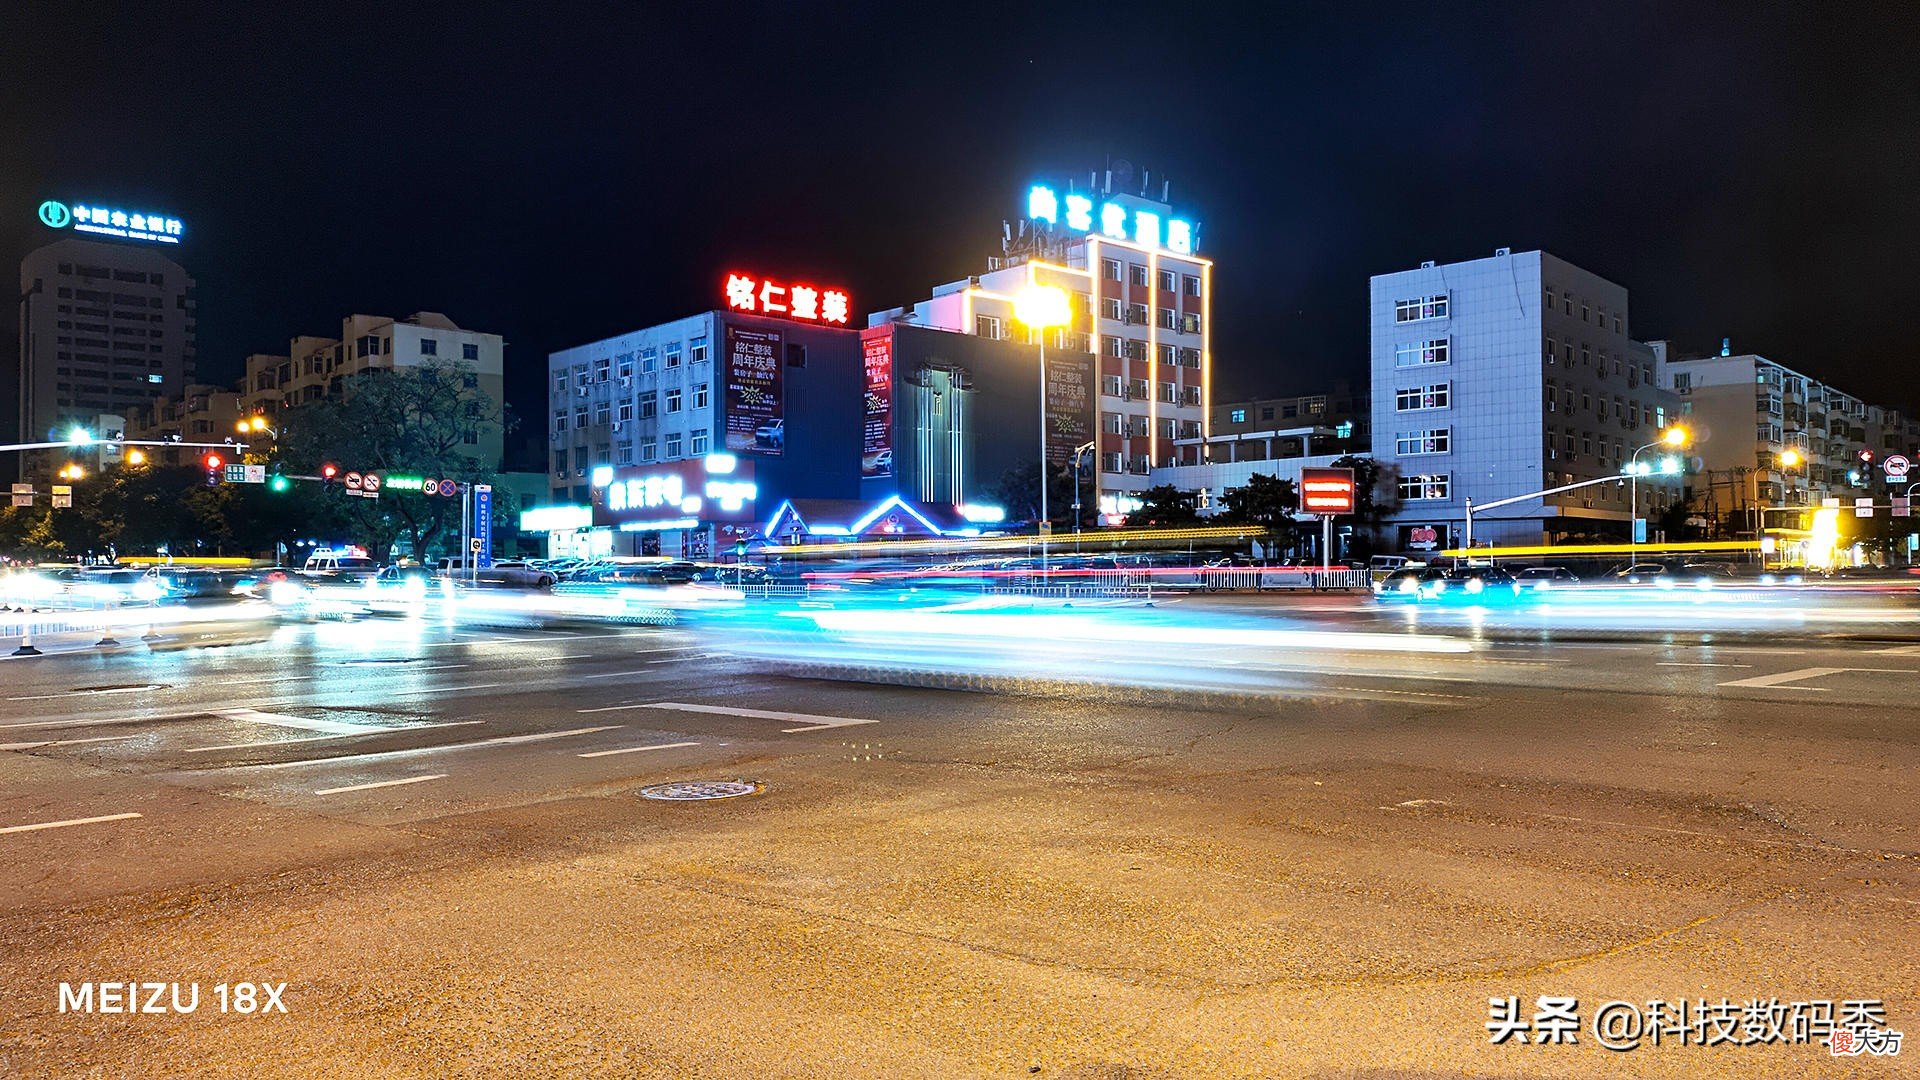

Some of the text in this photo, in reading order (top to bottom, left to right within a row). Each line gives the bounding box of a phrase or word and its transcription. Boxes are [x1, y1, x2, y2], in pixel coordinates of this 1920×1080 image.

[73, 205, 183, 235] 中国农业银行
[726, 274, 849, 324] 铭仁整装
[735, 341, 772, 356] 铭仁整装
[732, 353, 776, 371] 周年庆典
[1050, 369, 1083, 384] 铭仁整装
[1048, 382, 1086, 400] 周年庆典
[425, 482, 436, 492] 60
